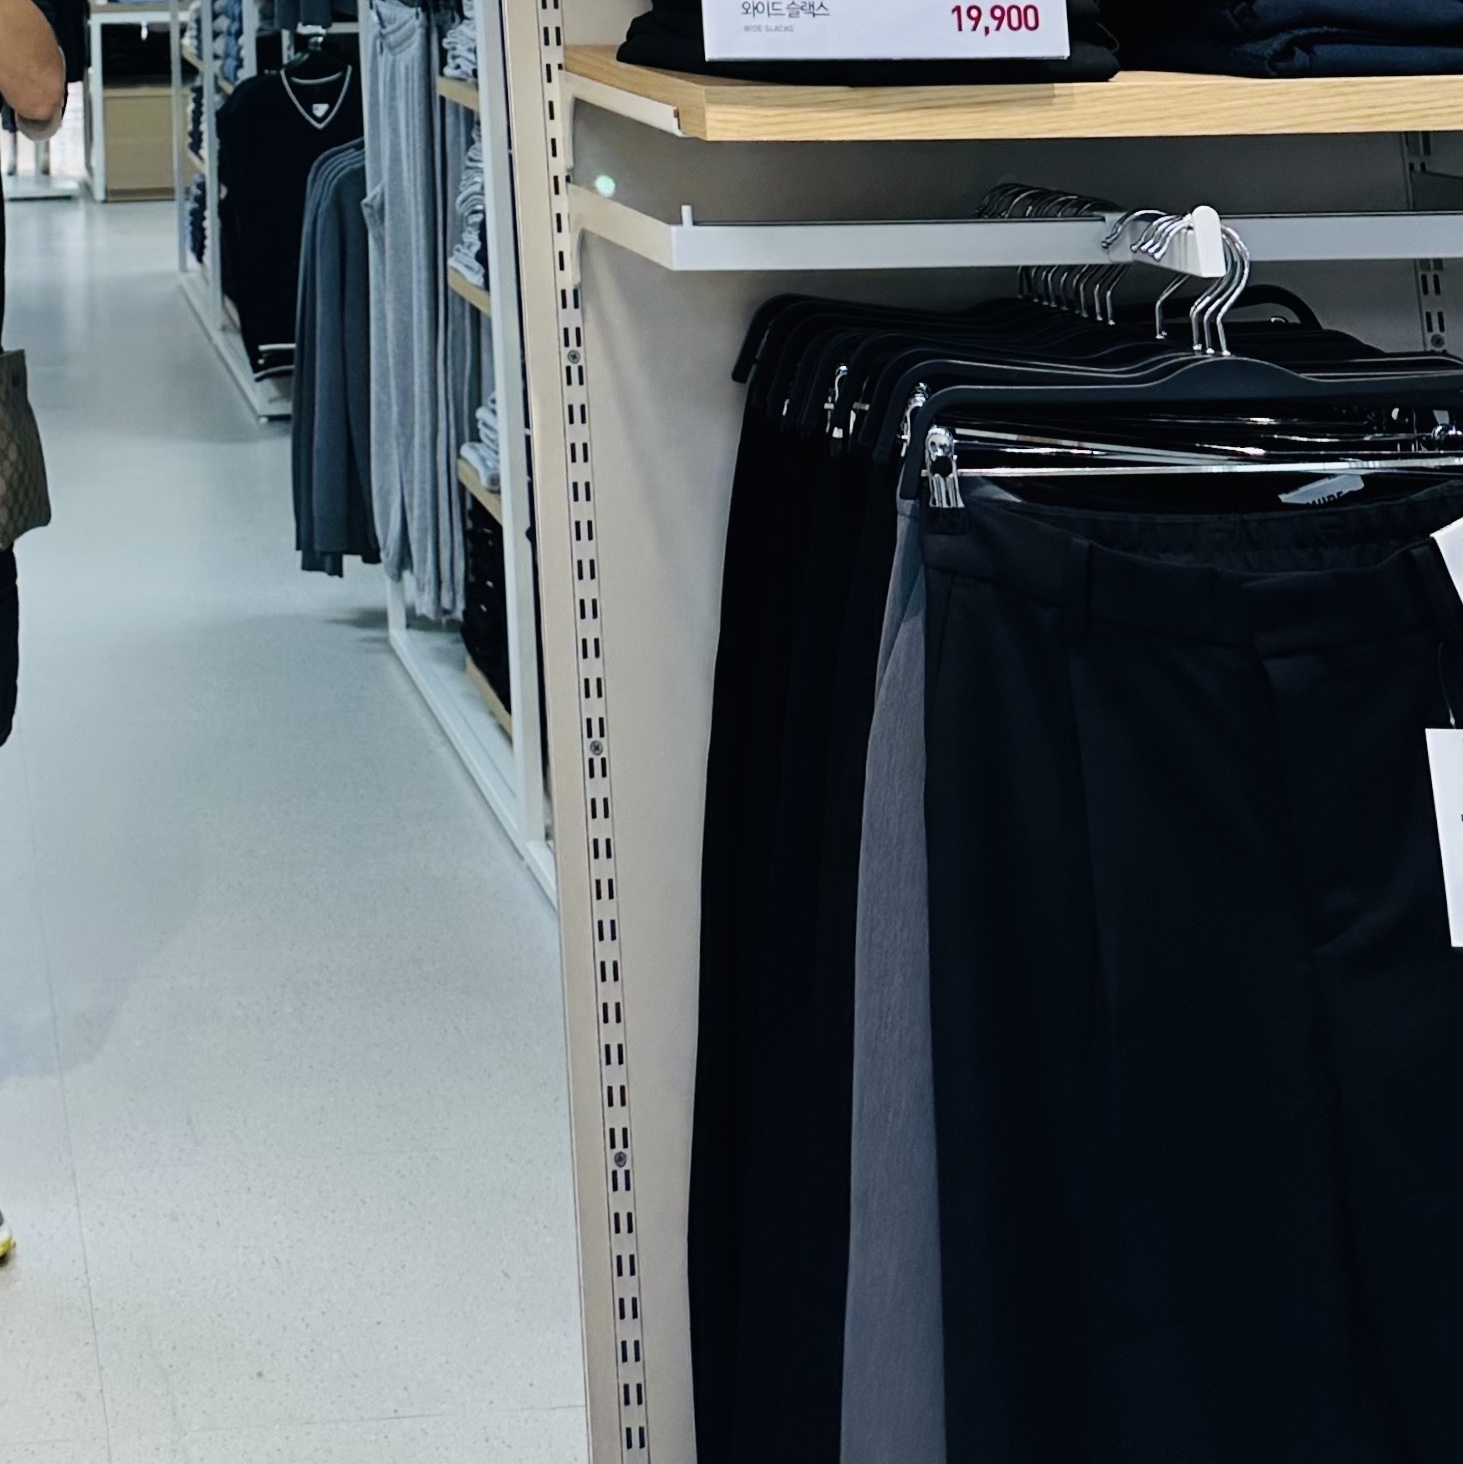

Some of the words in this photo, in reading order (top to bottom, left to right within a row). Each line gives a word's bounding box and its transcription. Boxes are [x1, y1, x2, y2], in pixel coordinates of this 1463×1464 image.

[741, 1, 786, 18] 와이드
[786, 1, 831, 18] 슬랙스
[951, 4, 1040, 37] 19,900
